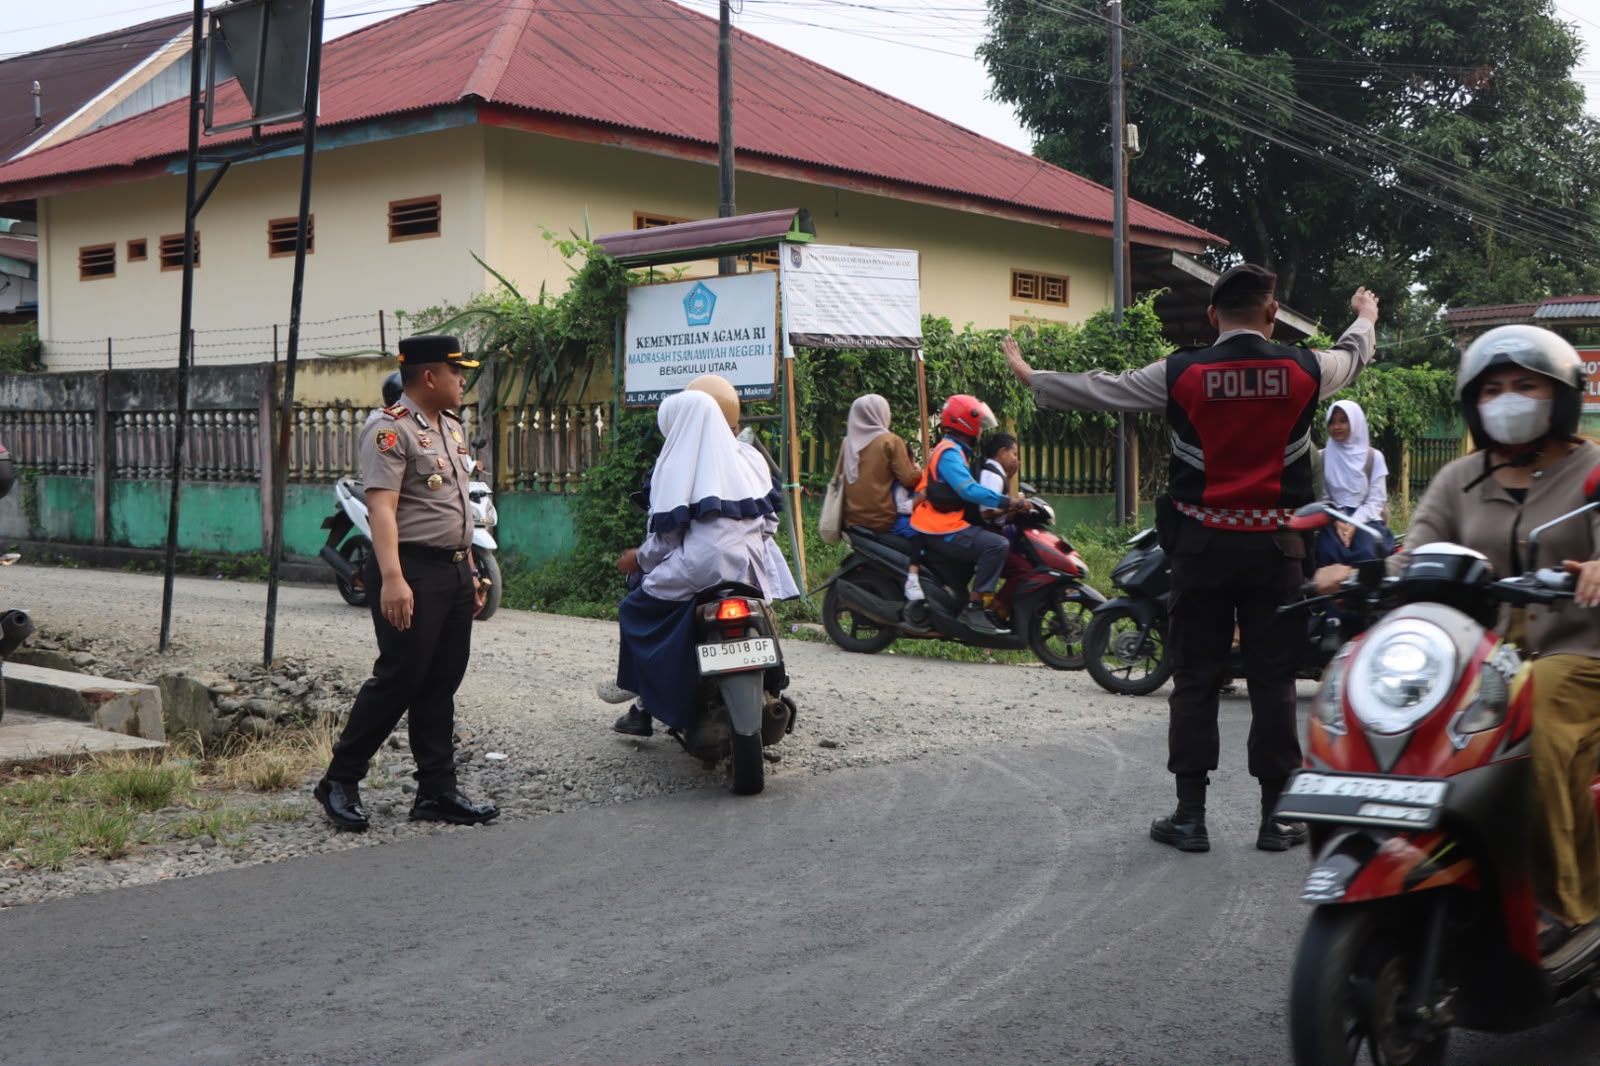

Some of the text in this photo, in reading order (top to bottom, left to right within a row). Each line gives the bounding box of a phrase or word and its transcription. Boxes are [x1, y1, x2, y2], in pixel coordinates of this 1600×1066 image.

[636, 326, 766, 349] KEMENTERIAN AGAMA RI
[628, 343, 773, 365] MADRASAH TSANAWIYAH NEGERI 1
[659, 361, 738, 376] BENGKULU UTARA
[744, 387, 772, 397] Makmur
[1206, 369, 1288, 398] POLISI
[701, 646, 717, 658] BD
[721, 642, 751, 655] 5018
